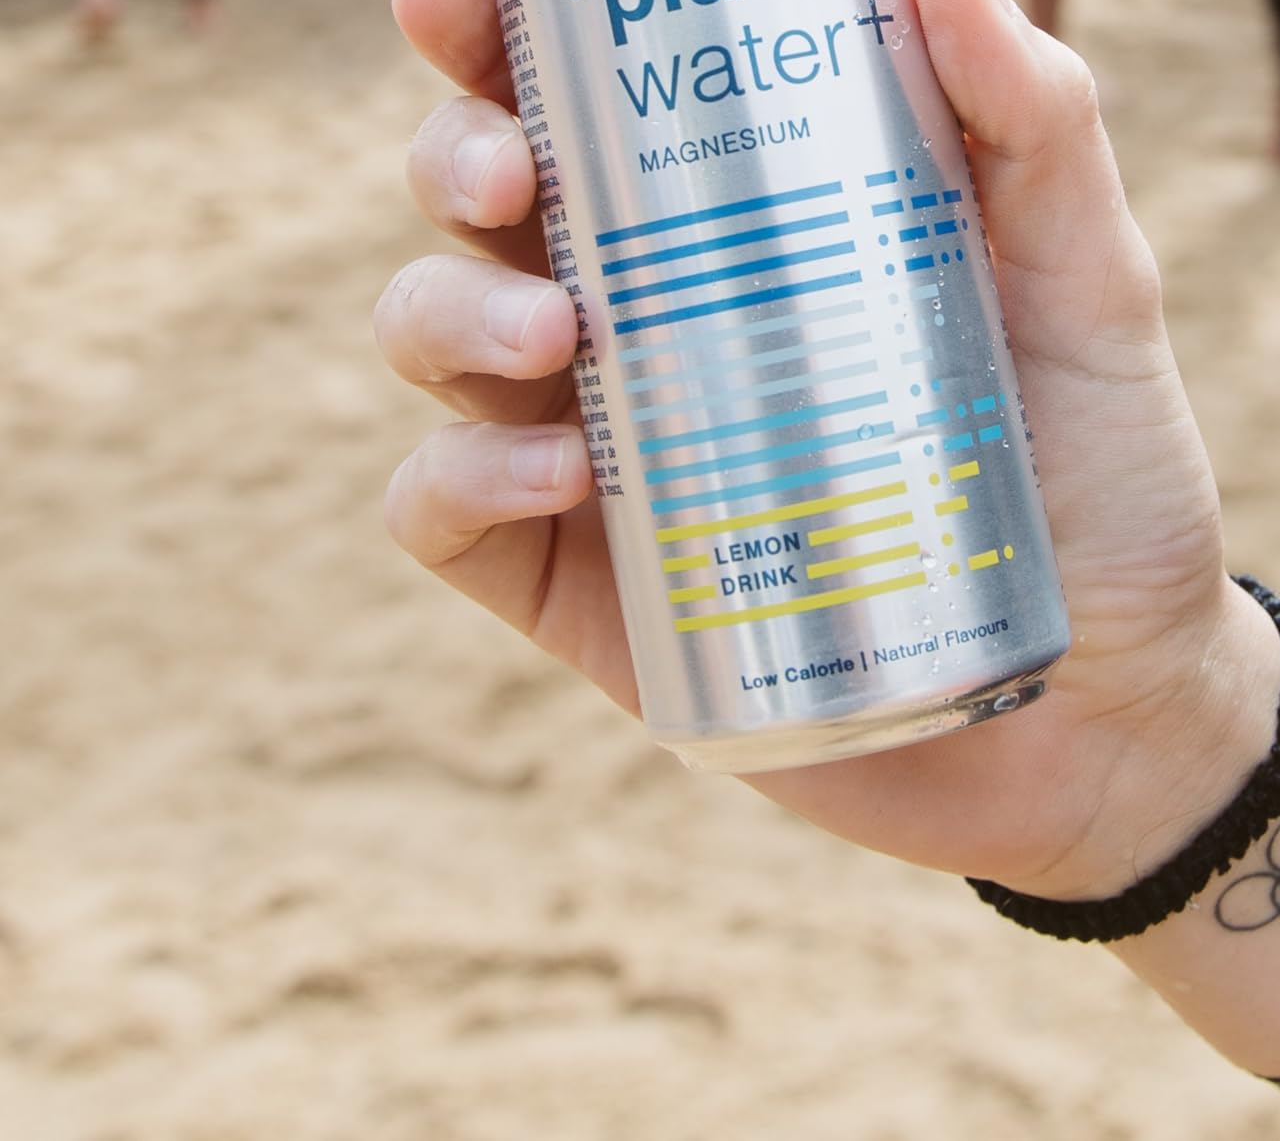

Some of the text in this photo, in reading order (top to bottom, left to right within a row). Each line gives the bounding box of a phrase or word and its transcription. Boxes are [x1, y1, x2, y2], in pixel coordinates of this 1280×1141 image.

[639, 116, 811, 174] MAGNESIUM
[714, 531, 801, 567] LEMON
[721, 564, 798, 597] DRINK
[741, 617, 1009, 691] Low Calorie Natural Flavours
